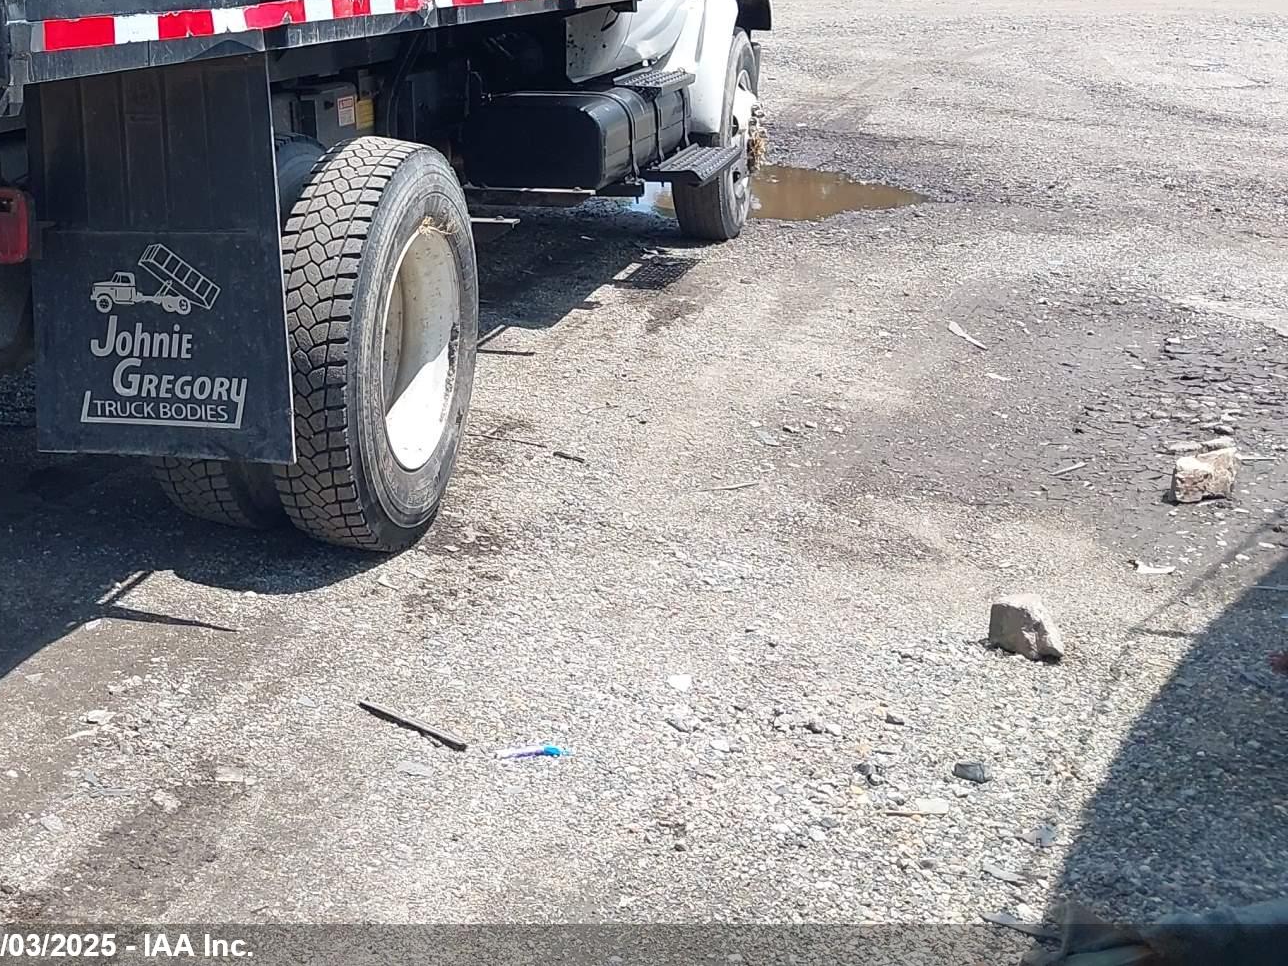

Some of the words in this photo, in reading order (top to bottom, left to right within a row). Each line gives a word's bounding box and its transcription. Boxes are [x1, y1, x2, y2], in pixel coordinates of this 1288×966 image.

[112, 358, 248, 403] GREGORY
[93, 400, 156, 418] TRUCK
[161, 403, 229, 421] BODIES
